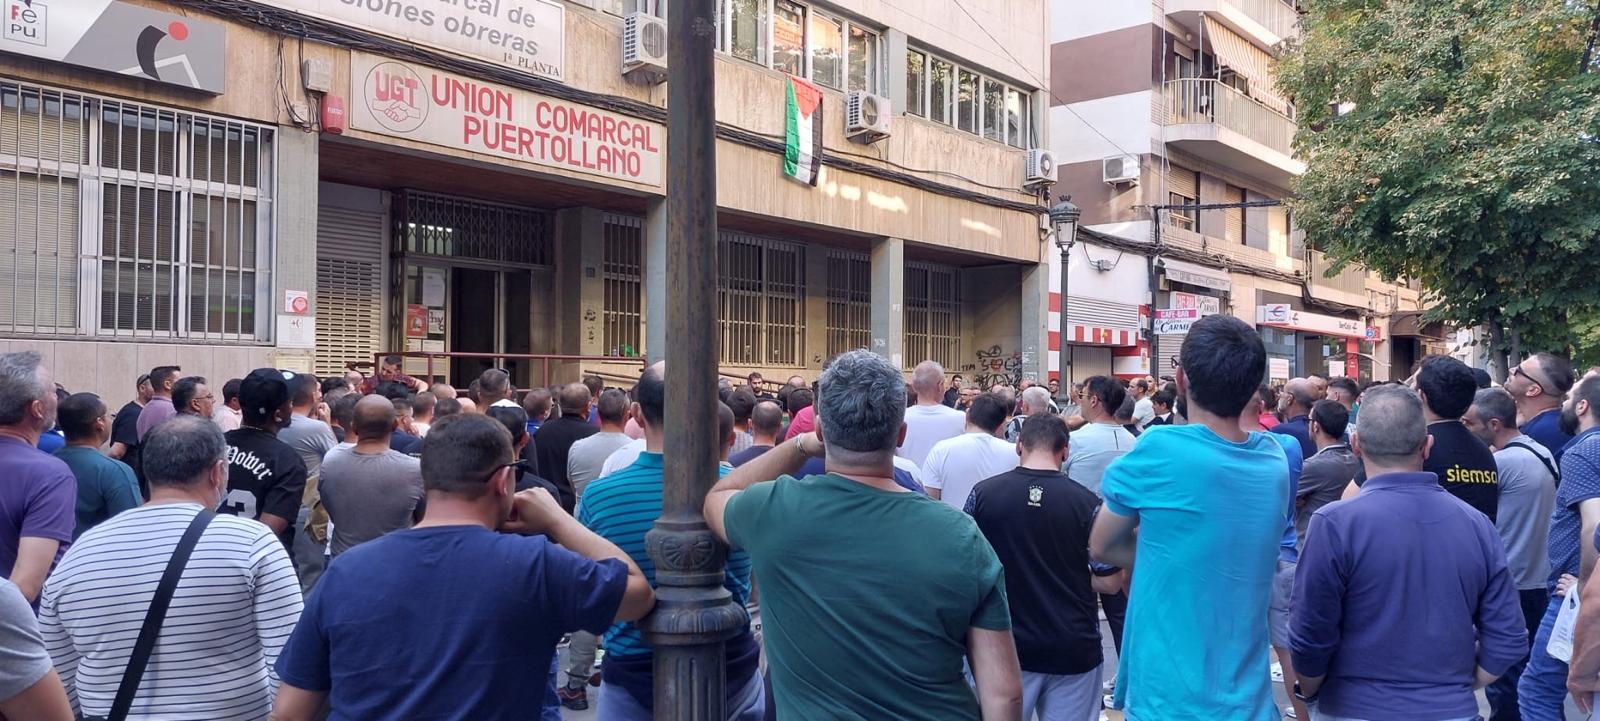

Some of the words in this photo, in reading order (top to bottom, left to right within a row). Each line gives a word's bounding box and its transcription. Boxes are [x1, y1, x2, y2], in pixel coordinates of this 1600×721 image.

[444, 16, 539, 56] obreras
[507, 7, 537, 28] de
[518, 57, 560, 77] PLANTA
[375, 71, 418, 108] UGT
[431, 74, 513, 122] UNION
[536, 101, 658, 153] COMARCAL
[463, 115, 641, 178] PUERTOLLANO
